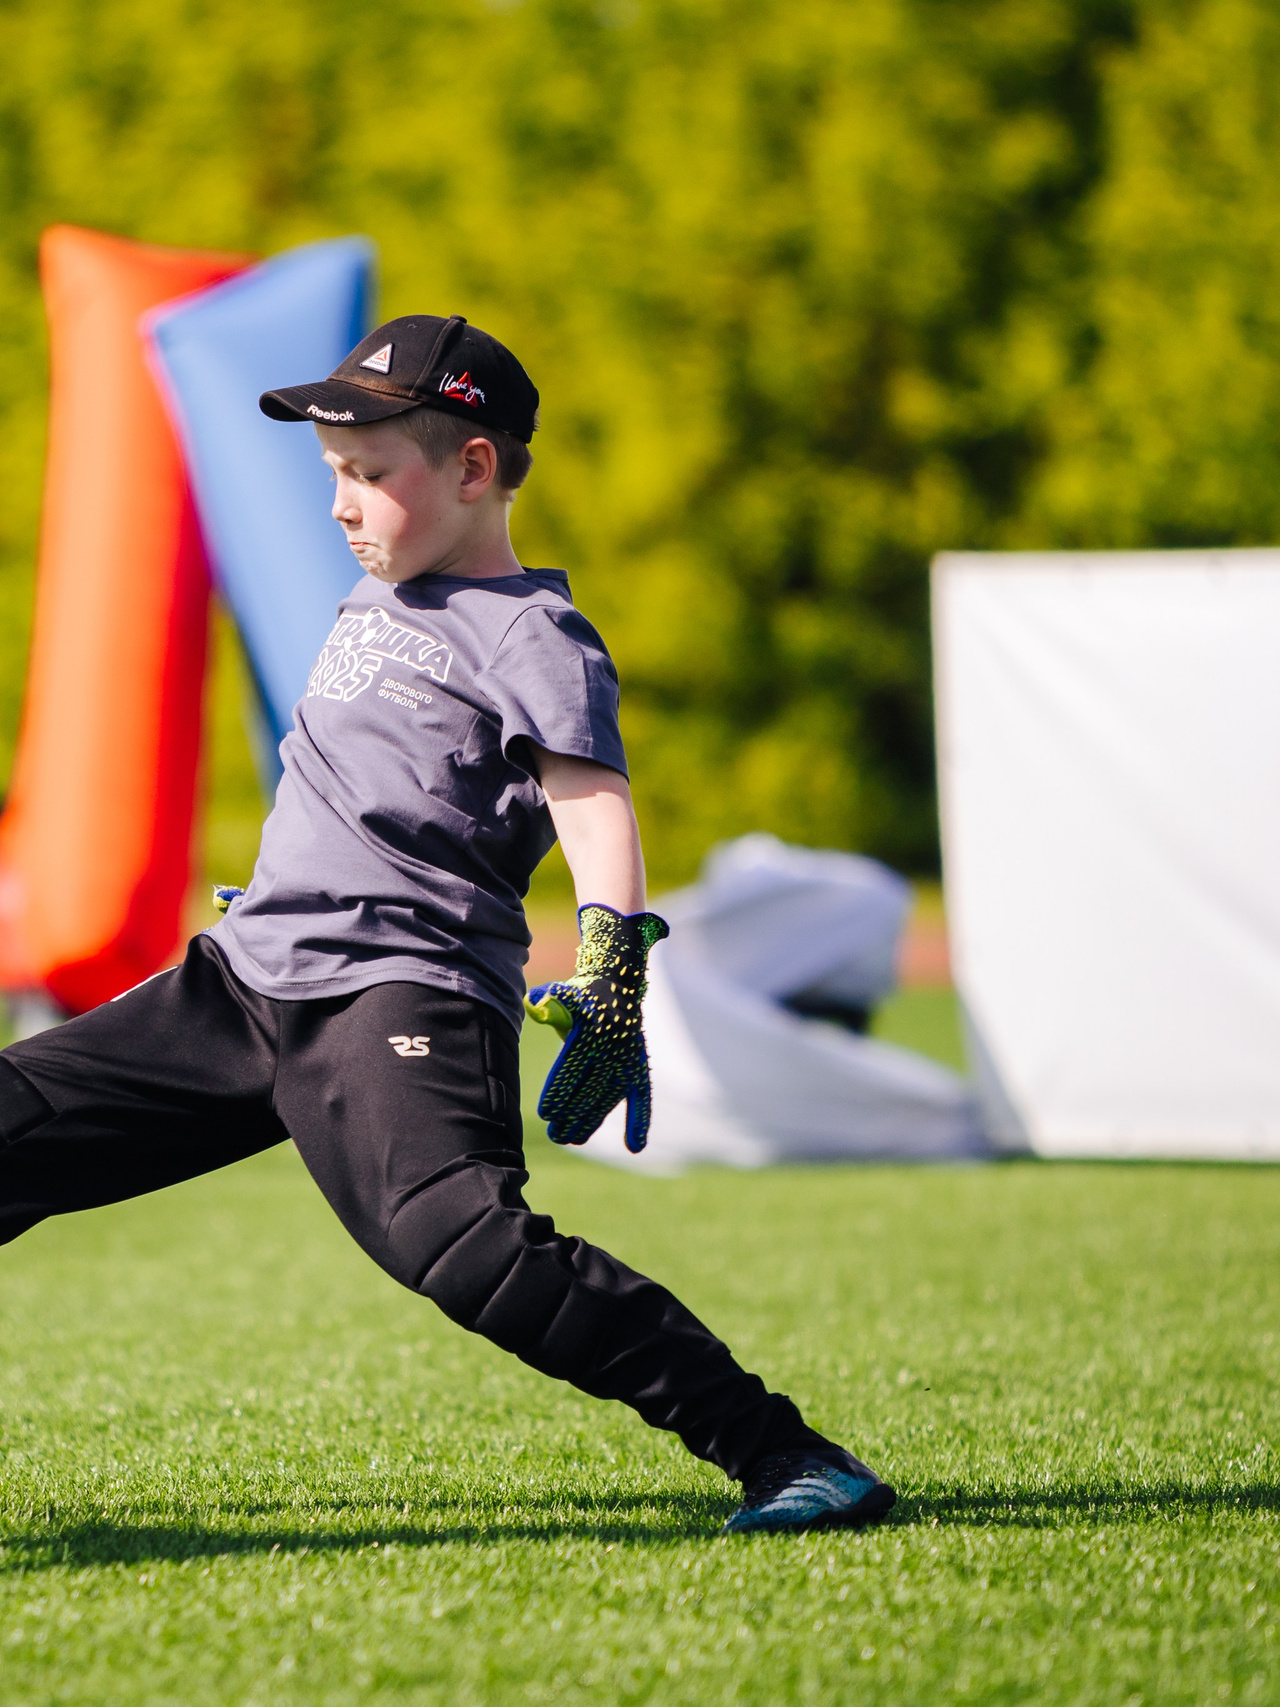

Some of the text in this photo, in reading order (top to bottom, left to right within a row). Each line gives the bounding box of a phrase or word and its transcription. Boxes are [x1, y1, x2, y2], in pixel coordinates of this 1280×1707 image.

[307, 404, 355, 421] Reebok
[377, 689, 419, 711] ФУТБОЛА
[380, 677, 433, 704] ДВОРОВОГО
